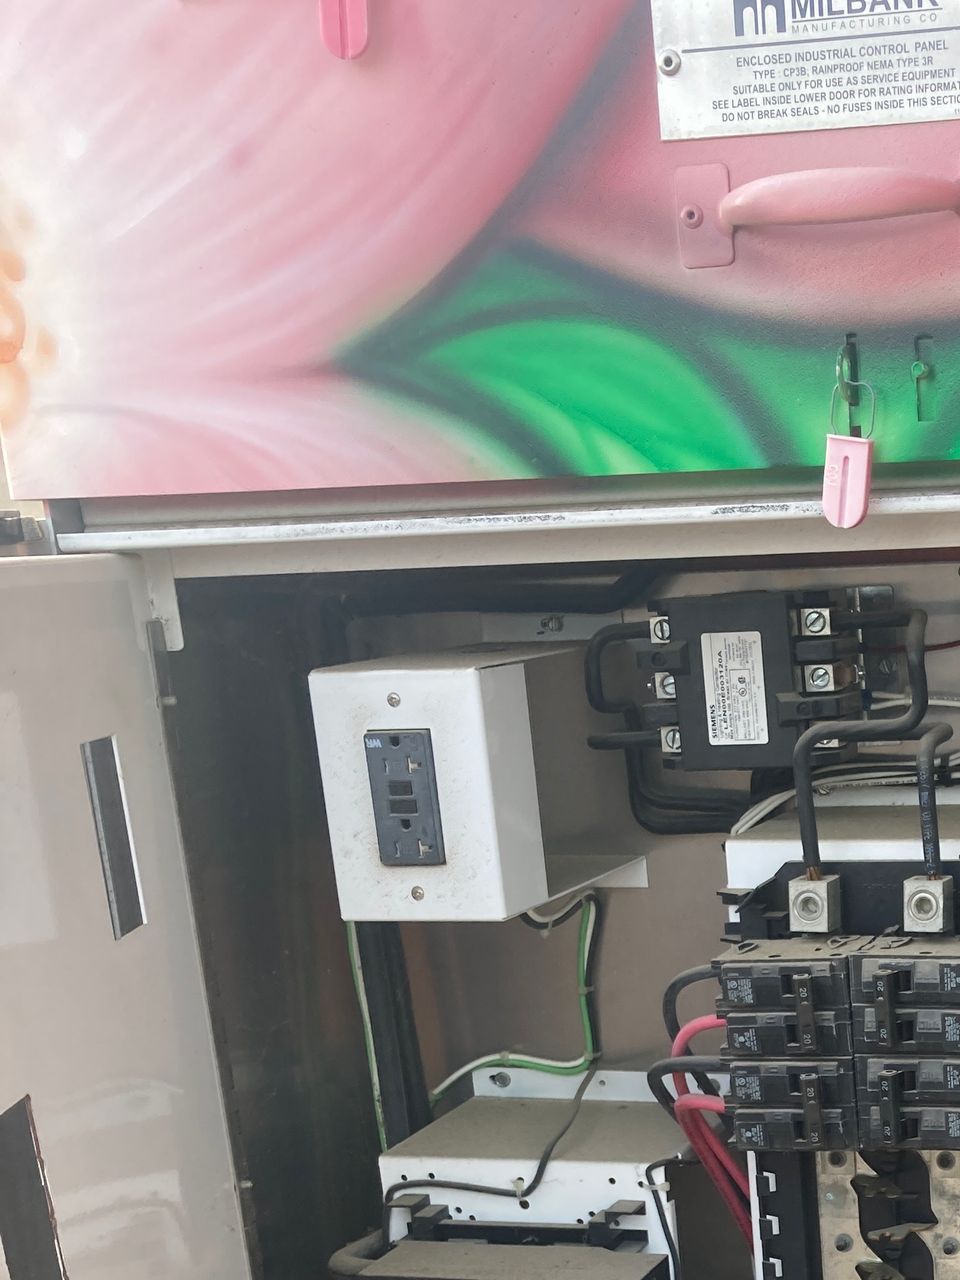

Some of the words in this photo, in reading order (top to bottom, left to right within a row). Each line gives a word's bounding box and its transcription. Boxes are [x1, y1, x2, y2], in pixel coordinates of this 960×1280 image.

[791, 15, 911, 34] MANUFACTURING
[919, 12, 937, 23] CO
[736, 52, 792, 68] ENCLOSED
[794, 47, 856, 63] INDUSTRIAL
[859, 43, 910, 57] CONTROL
[914, 39, 949, 53] PANEL
[753, 69, 776, 80] TYPE
[811, 62, 864, 75] RAINPROOF
[867, 59, 893, 71] NEMA
[897, 56, 919, 67] TYPE
[921, 55, 933, 66] 3R
[732, 82, 776, 95] SUITABLE
[778, 79, 802, 92] ONLY
[804, 78, 823, 89] FOR
[825, 77, 843, 88] USE
[846, 75, 858, 86] AS
[861, 72, 900, 85] SERVICE
[902, 68, 956, 82] EQUIPMENT
[712, 99, 729, 110] SEE
[731, 97, 760, 108] LABEL
[763, 95, 792, 106] INSIDE
[794, 92, 827, 104] LOWER
[829, 89, 855, 101] DOOR
[858, 87, 876, 98] FOR
[879, 84, 913, 96] RATING
[722, 112, 735, 122] DO
[737, 110, 755, 121] NOT
[757, 108, 788, 120] BREAK
[791, 106, 819, 117] SEALS
[827, 104, 840, 114] NO
[843, 101, 872, 113] FUSES
[875, 99, 905, 110] INSIDE
[907, 97, 928, 107] THIS
[709, 704, 717, 739] SIEMENS
[877, 981, 884, 991] 20
[800, 987, 807, 997] 20
[804, 1033, 811, 1044] 20
[880, 1028, 887, 1039] 20
[881, 1080, 888, 1091] 20
[807, 1087, 814, 1097] 20
[810, 1131, 818, 1142] 20
[883, 1126, 891, 1137] 20
